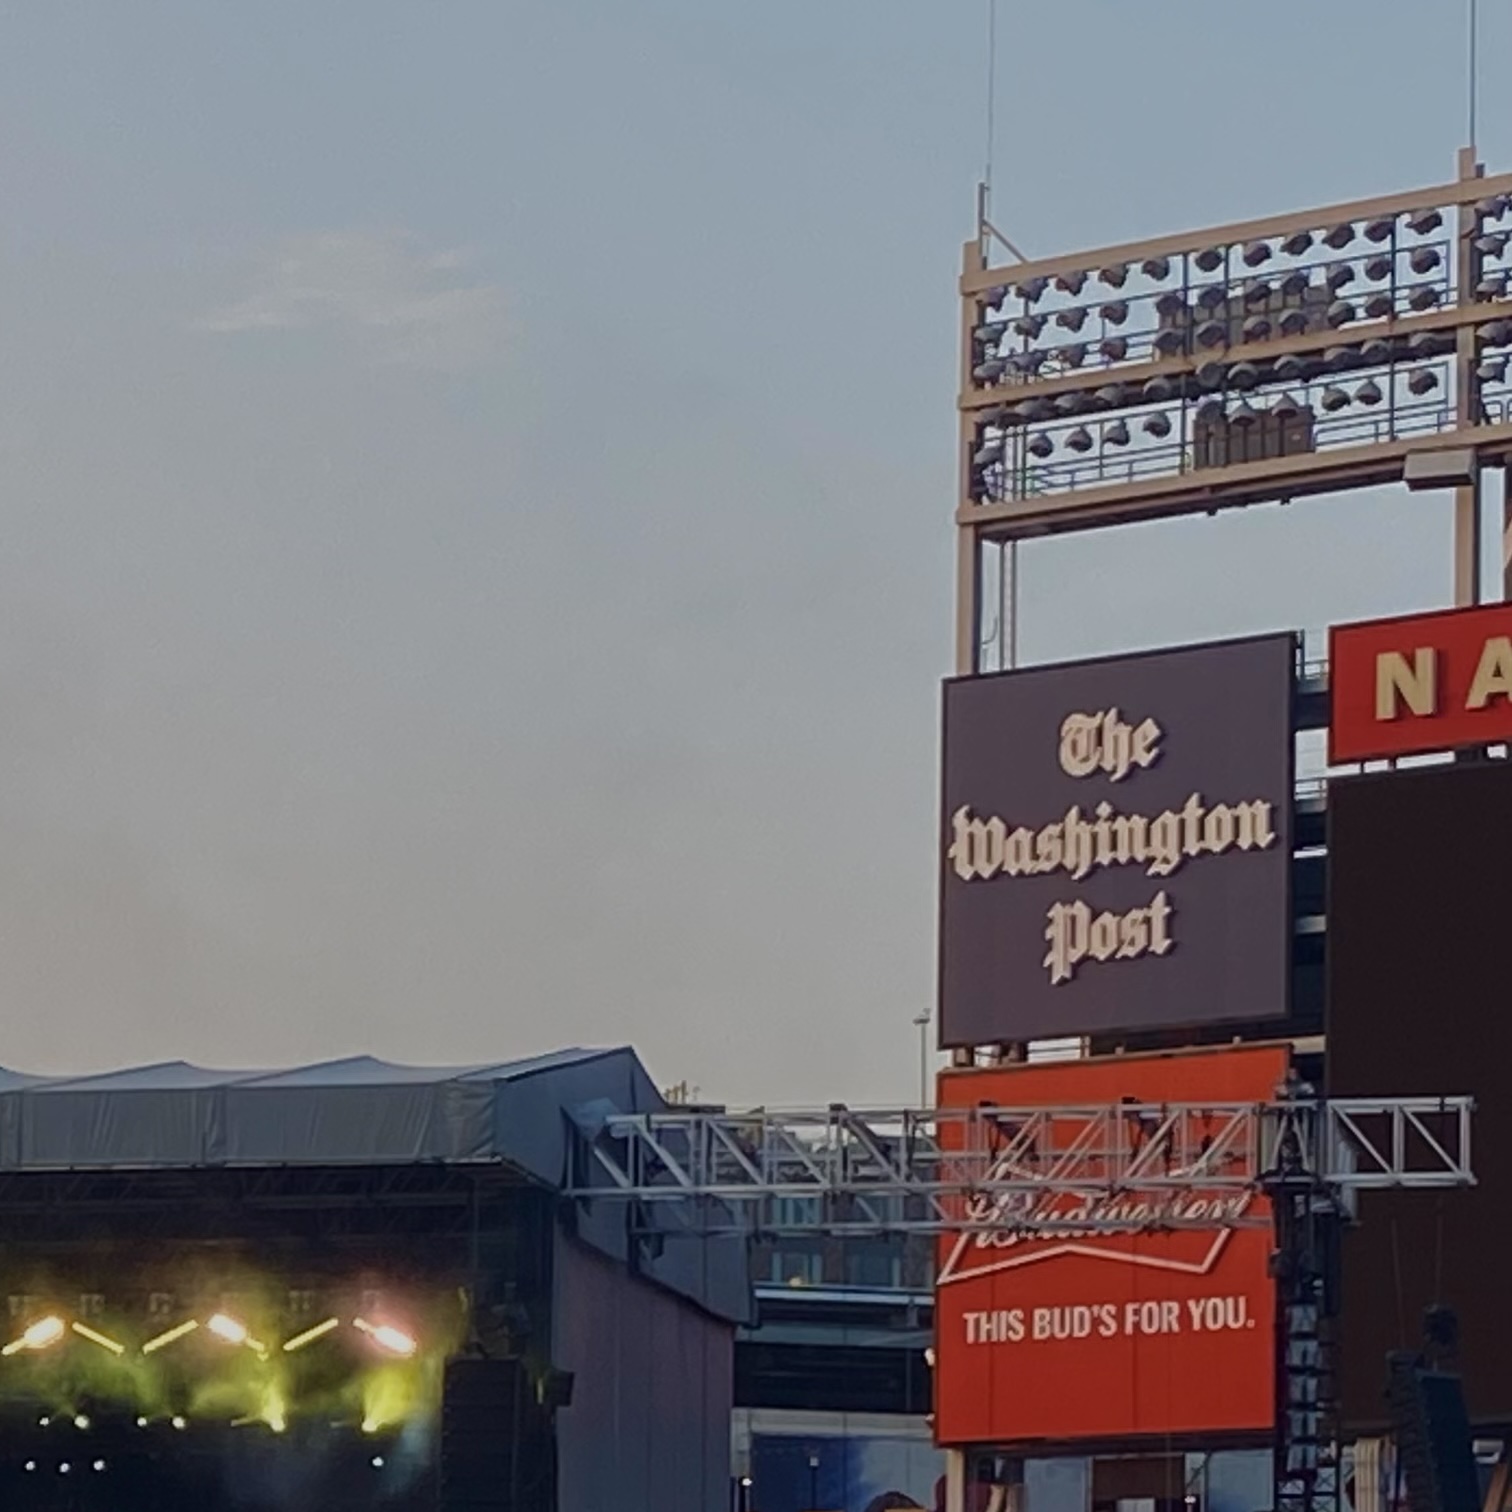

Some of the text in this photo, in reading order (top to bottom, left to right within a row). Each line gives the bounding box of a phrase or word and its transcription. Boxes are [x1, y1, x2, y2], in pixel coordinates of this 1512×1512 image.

[1059, 706, 1161, 783] The
[948, 792, 1276, 881] Washington
[1043, 890, 1173, 985] Post
[962, 1296, 1256, 1344] THIS BUD'S FOR YOU.
